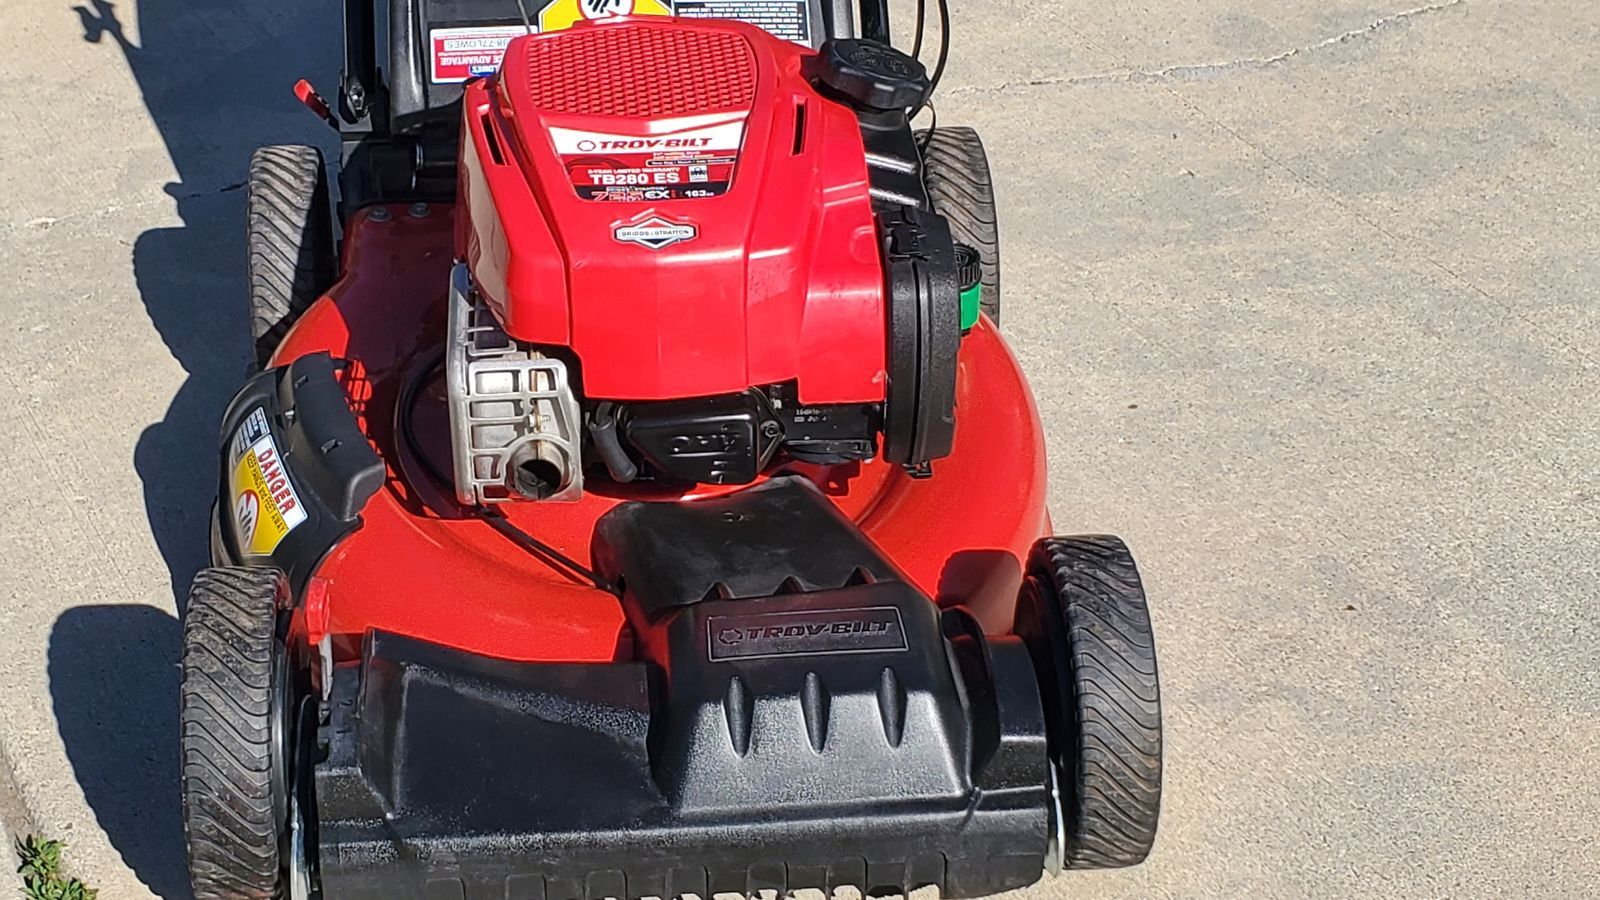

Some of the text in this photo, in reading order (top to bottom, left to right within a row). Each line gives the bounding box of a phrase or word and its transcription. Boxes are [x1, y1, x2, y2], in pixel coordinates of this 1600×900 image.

[440, 55, 491, 66] ADVANTAGE
[599, 138, 713, 150] TROY-BILT
[589, 173, 649, 185] TB280
[654, 172, 680, 184] ES
[258, 448, 296, 515] DANGER
[251, 468, 265, 489] HANDS
[263, 497, 277, 514] FEET
[271, 512, 286, 533] AWAY
[746, 621, 892, 640] TROY-BILT
